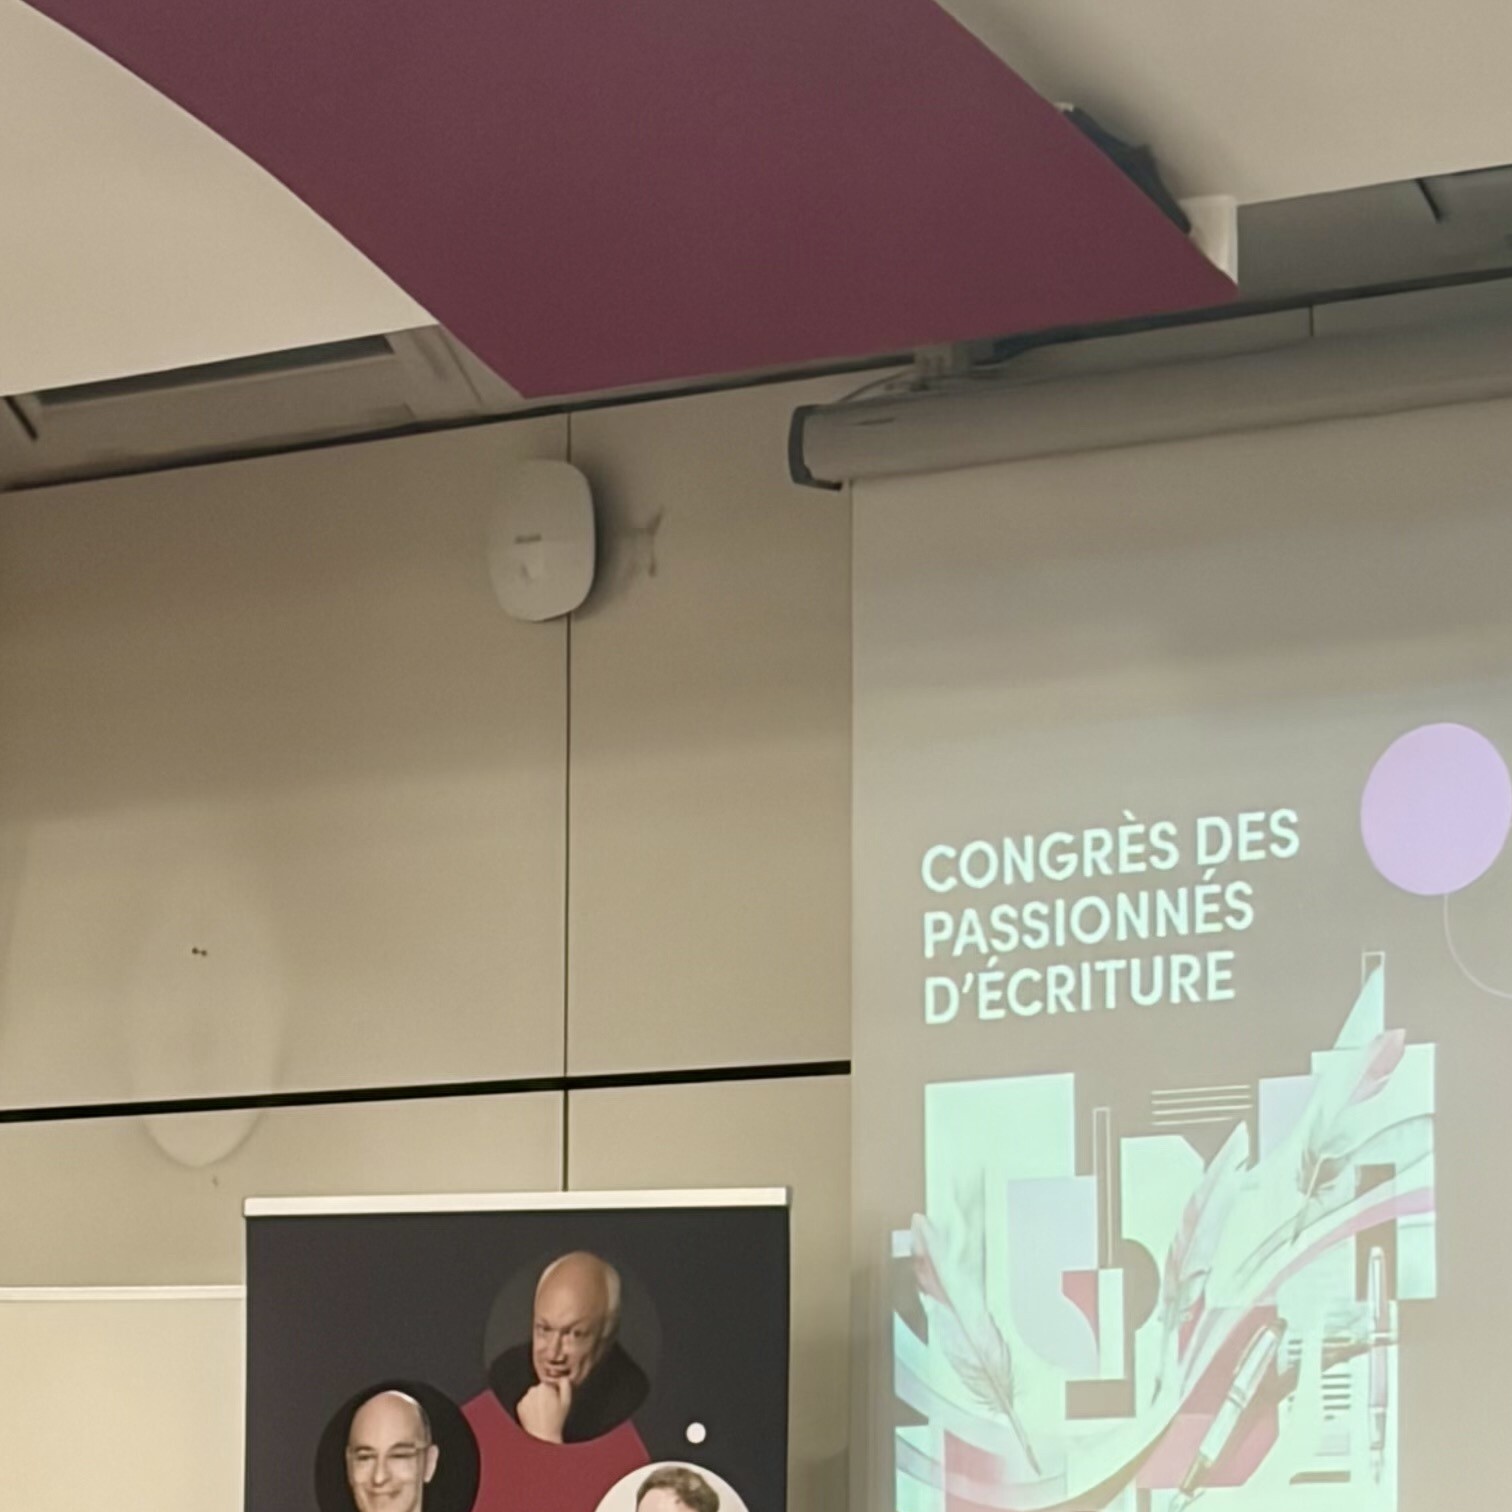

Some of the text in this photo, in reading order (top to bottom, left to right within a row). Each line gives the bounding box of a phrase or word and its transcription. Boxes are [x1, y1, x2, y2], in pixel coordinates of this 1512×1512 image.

[921, 808, 1300, 893] CONGRÈS DES
[923, 868, 1254, 958] PASSIONNÉS
[924, 950, 1236, 1024] D'ÉCRITURE
